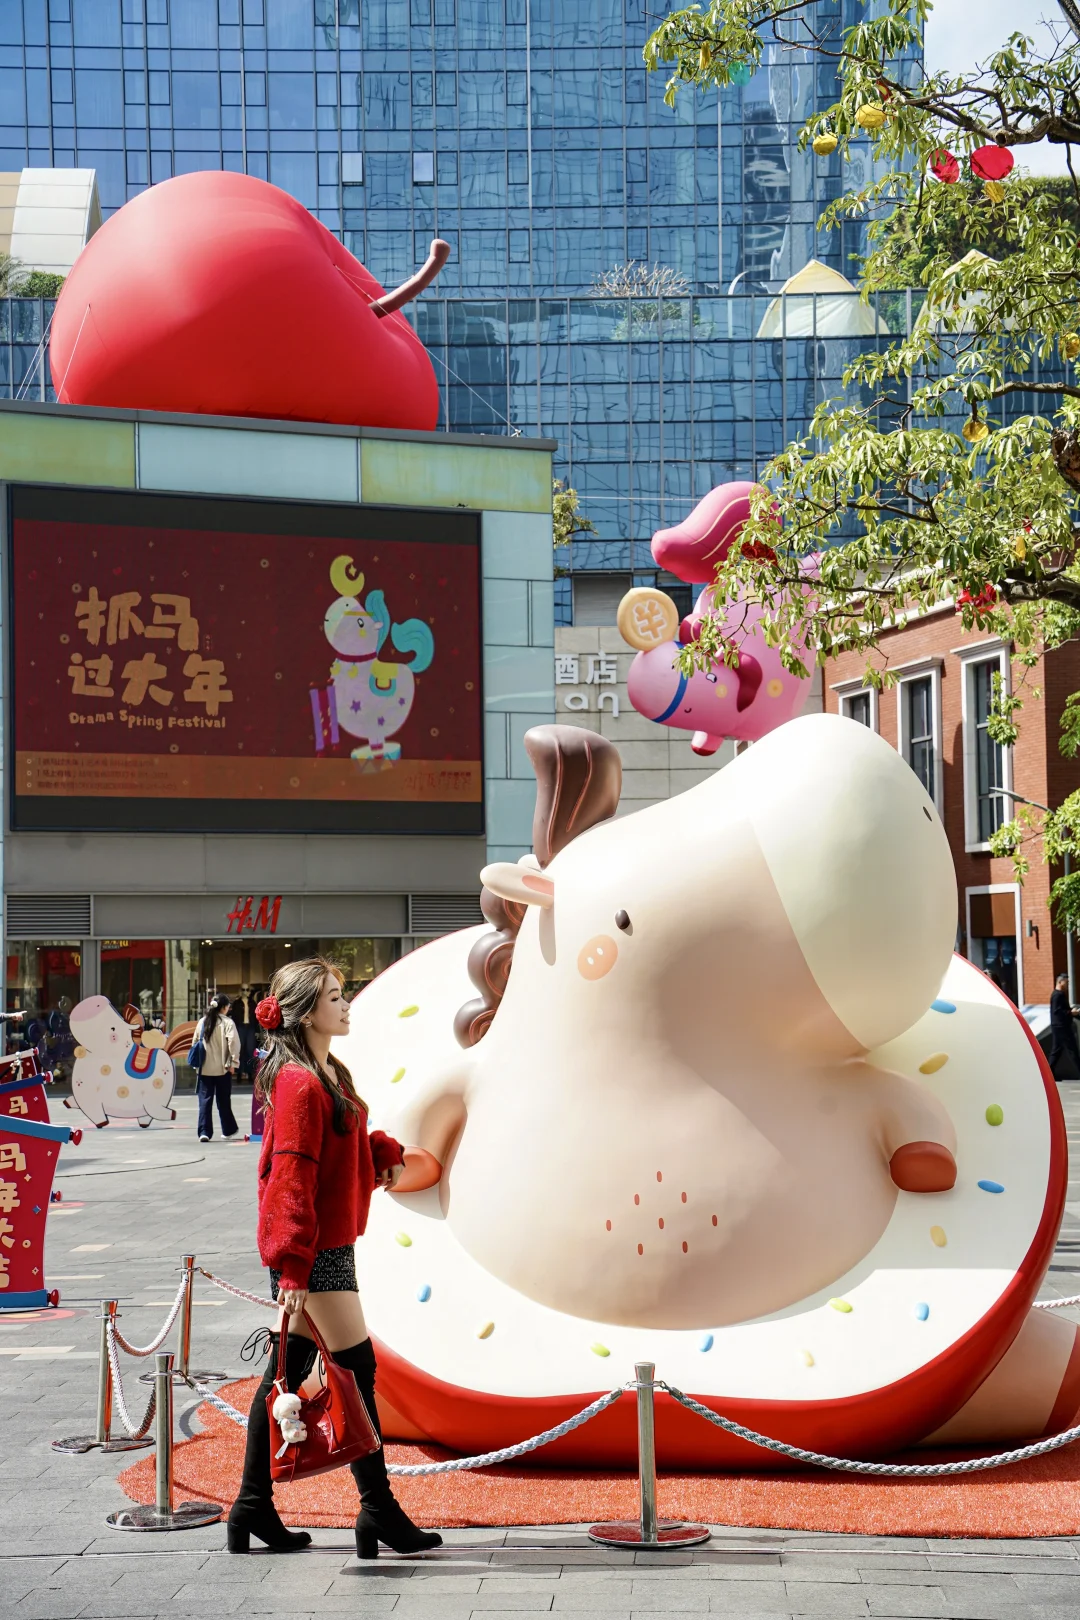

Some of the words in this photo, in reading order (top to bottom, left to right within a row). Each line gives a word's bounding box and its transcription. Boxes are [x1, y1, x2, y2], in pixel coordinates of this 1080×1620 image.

[75, 586, 199, 651] 抓马
[68, 652, 233, 716] 过大年
[555, 650, 617, 684] 酒店
[68, 711, 114, 724] Drama
[118, 709, 163, 730] Spring
[167, 715, 226, 728] Festival
[226, 895, 282, 934] H&M
